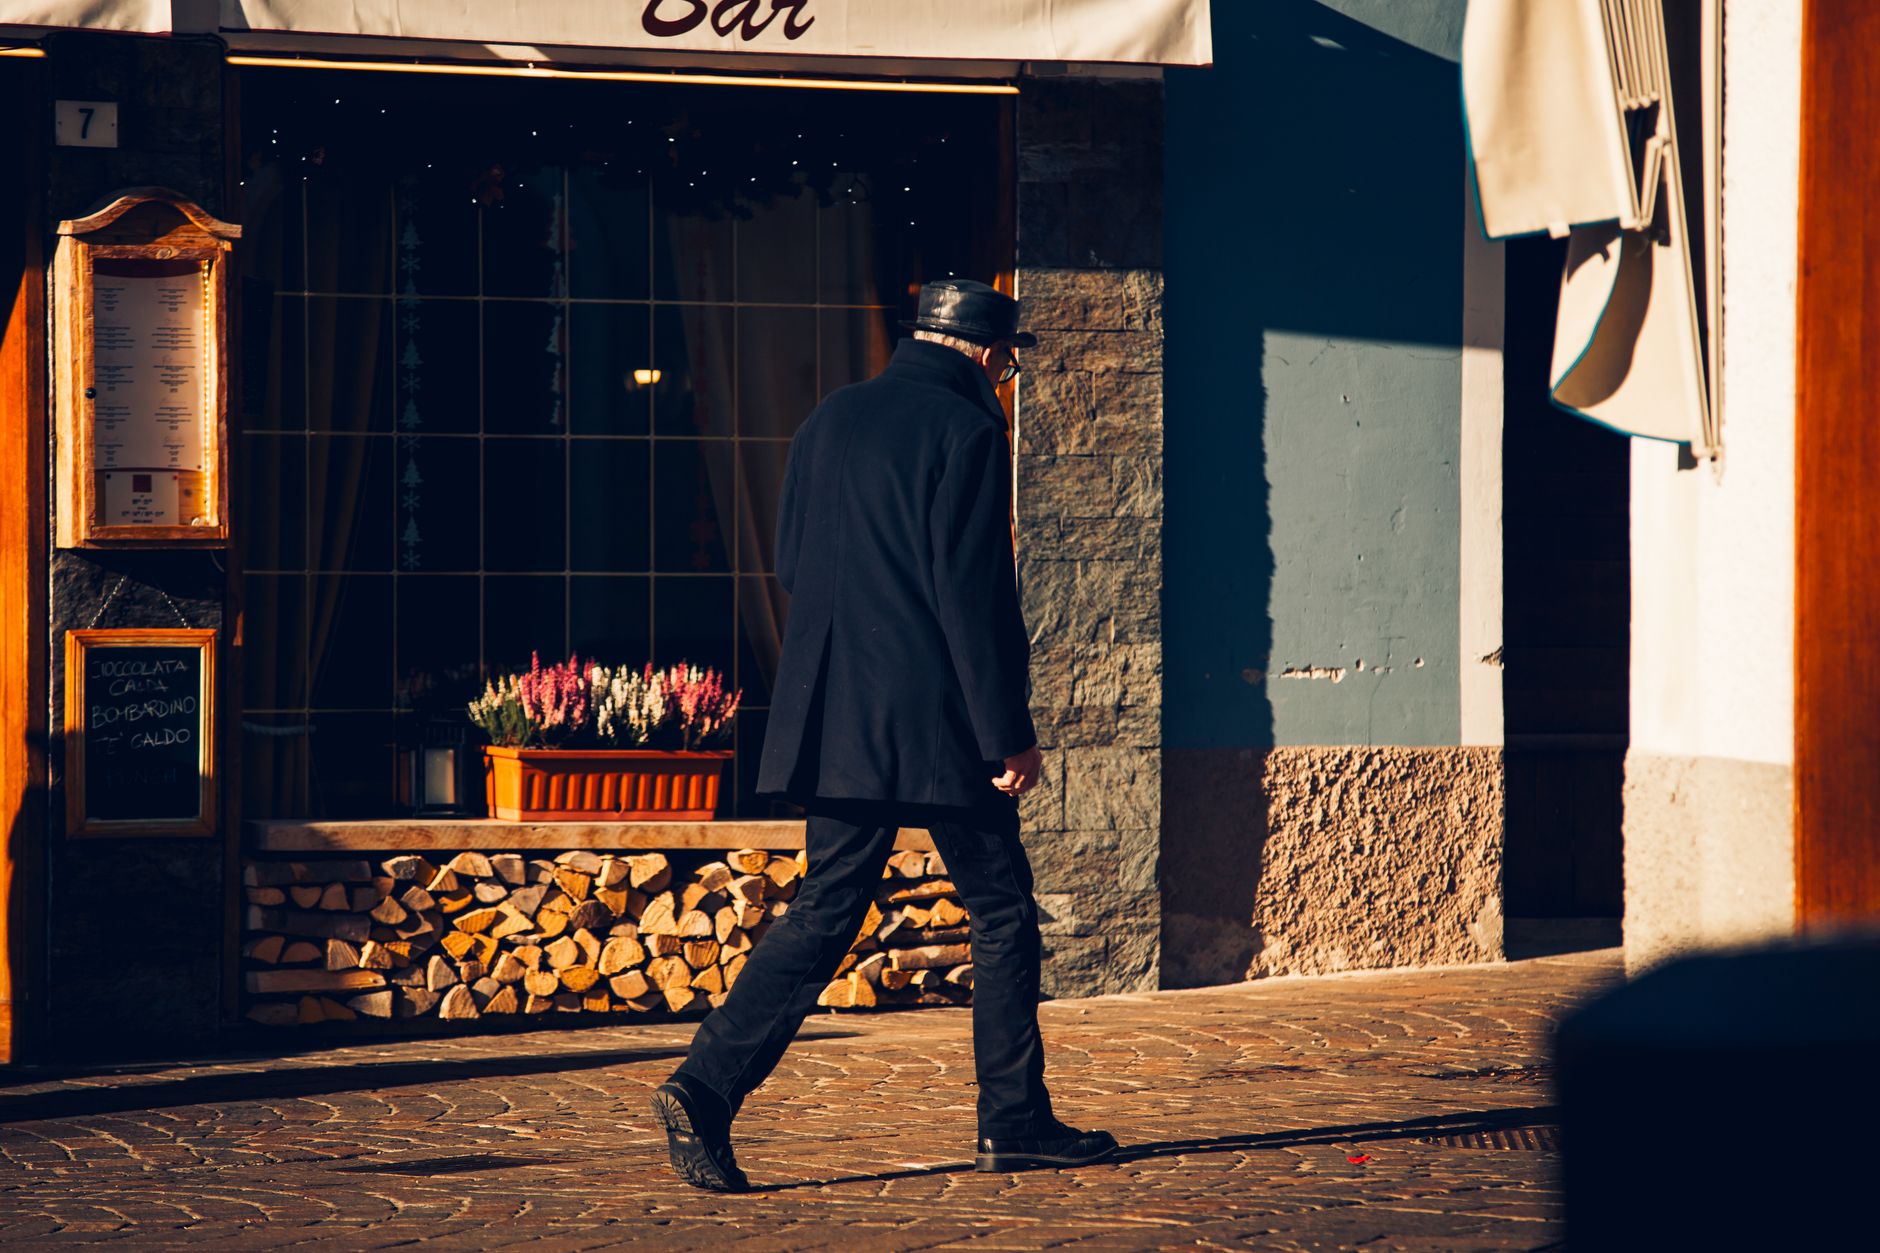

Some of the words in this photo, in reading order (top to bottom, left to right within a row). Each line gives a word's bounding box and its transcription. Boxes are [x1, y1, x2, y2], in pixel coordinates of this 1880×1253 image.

[79, 108, 95, 139] 7
[92, 696, 196, 729] BOMBARDINO
[130, 728, 191, 750] CALDO
